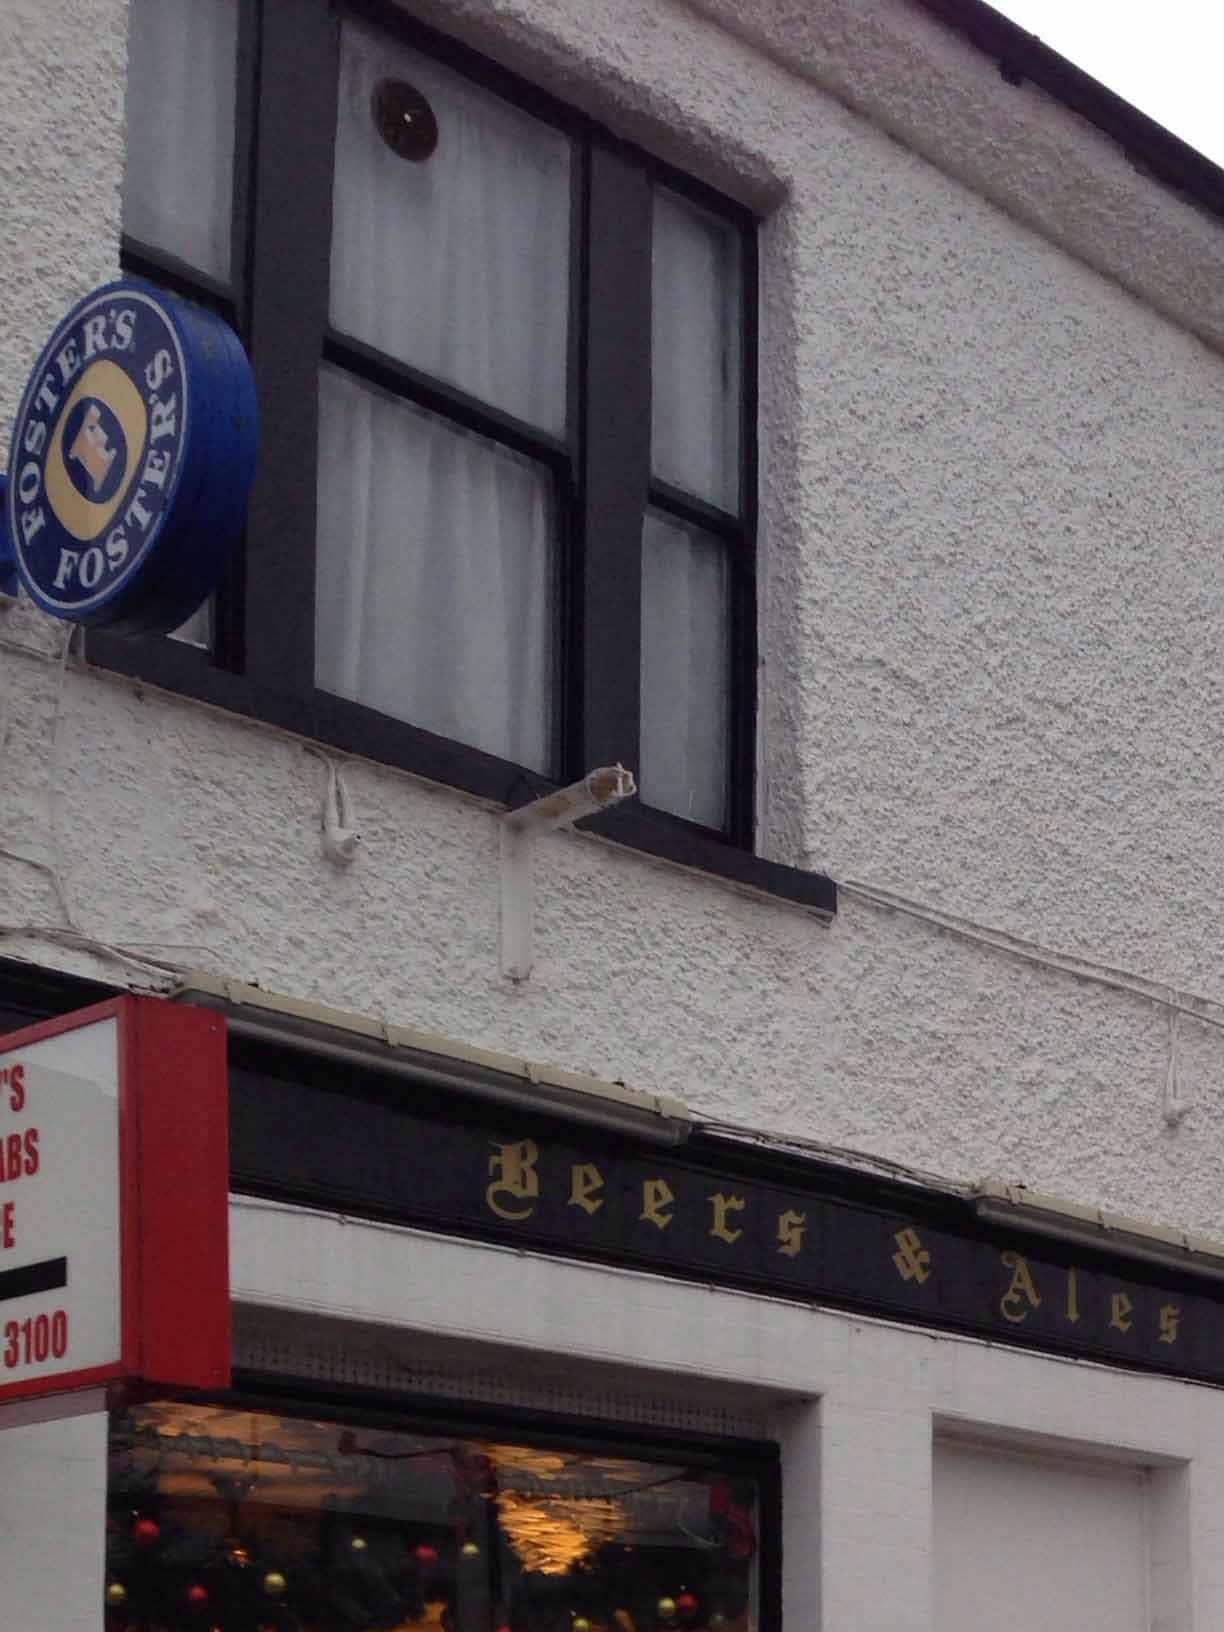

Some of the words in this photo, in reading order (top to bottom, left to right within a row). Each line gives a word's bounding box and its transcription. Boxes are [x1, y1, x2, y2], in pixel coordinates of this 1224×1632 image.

[19, 308, 137, 545] FOSTER'S
[53, 348, 177, 590] FOSTER'S
[0, 1064, 25, 1112] 'S
[5, 1309, 67, 1368] 3100
[486, 1138, 807, 1258] Beers
[892, 1227, 931, 1284] &
[1001, 1251, 1182, 1345] Ales
